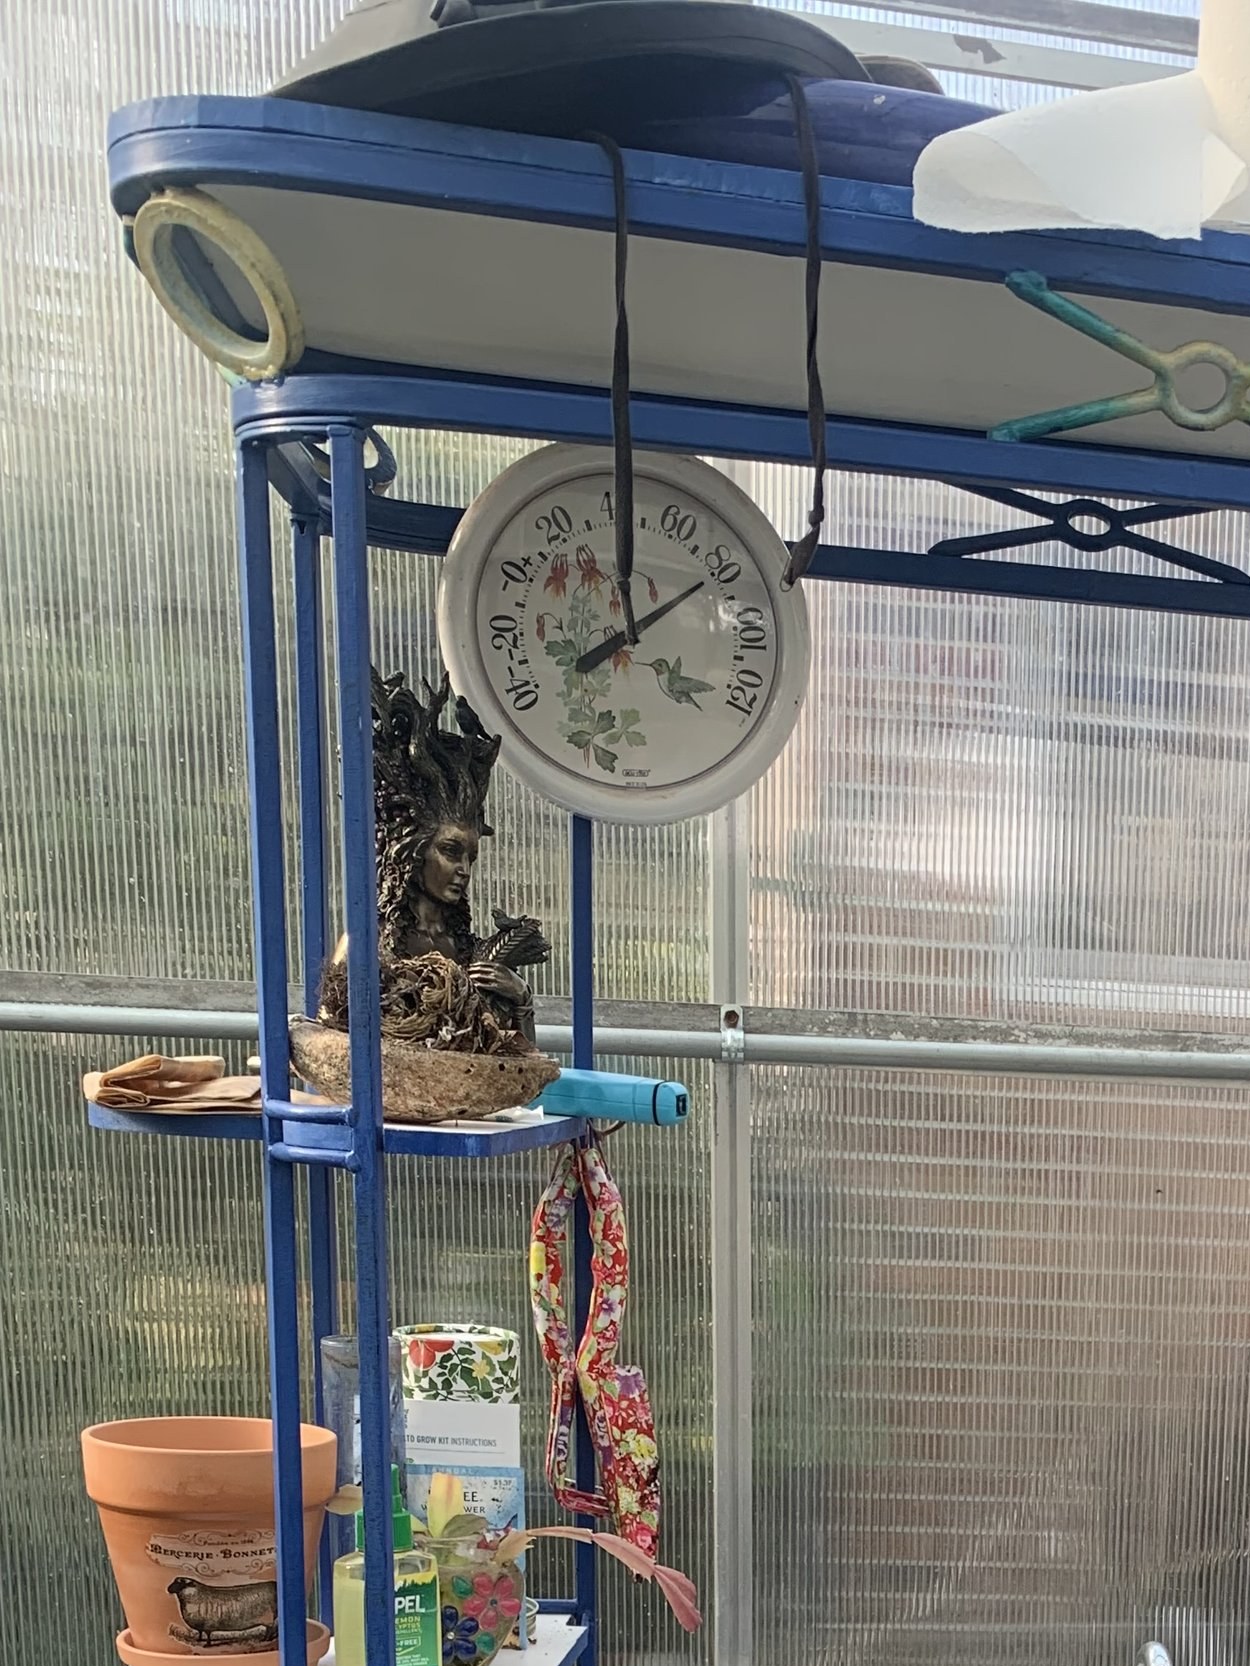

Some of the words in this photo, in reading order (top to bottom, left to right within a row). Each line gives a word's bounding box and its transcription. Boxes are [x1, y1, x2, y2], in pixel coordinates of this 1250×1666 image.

[535, 505, 573, 545] 20
[660, 504, 697, 541] 60
[704, 544, 741, 584] 80
[736, 607, 767, 651] 100
[725, 669, 764, 717] 120
[416, 1435, 437, 1445] GROW
[438, 1436, 450, 1445] KIT
[451, 1437, 497, 1448] INSTRUCTIONS
[394, 1594, 427, 1615] PEL
[395, 1615, 421, 1625] EMON
